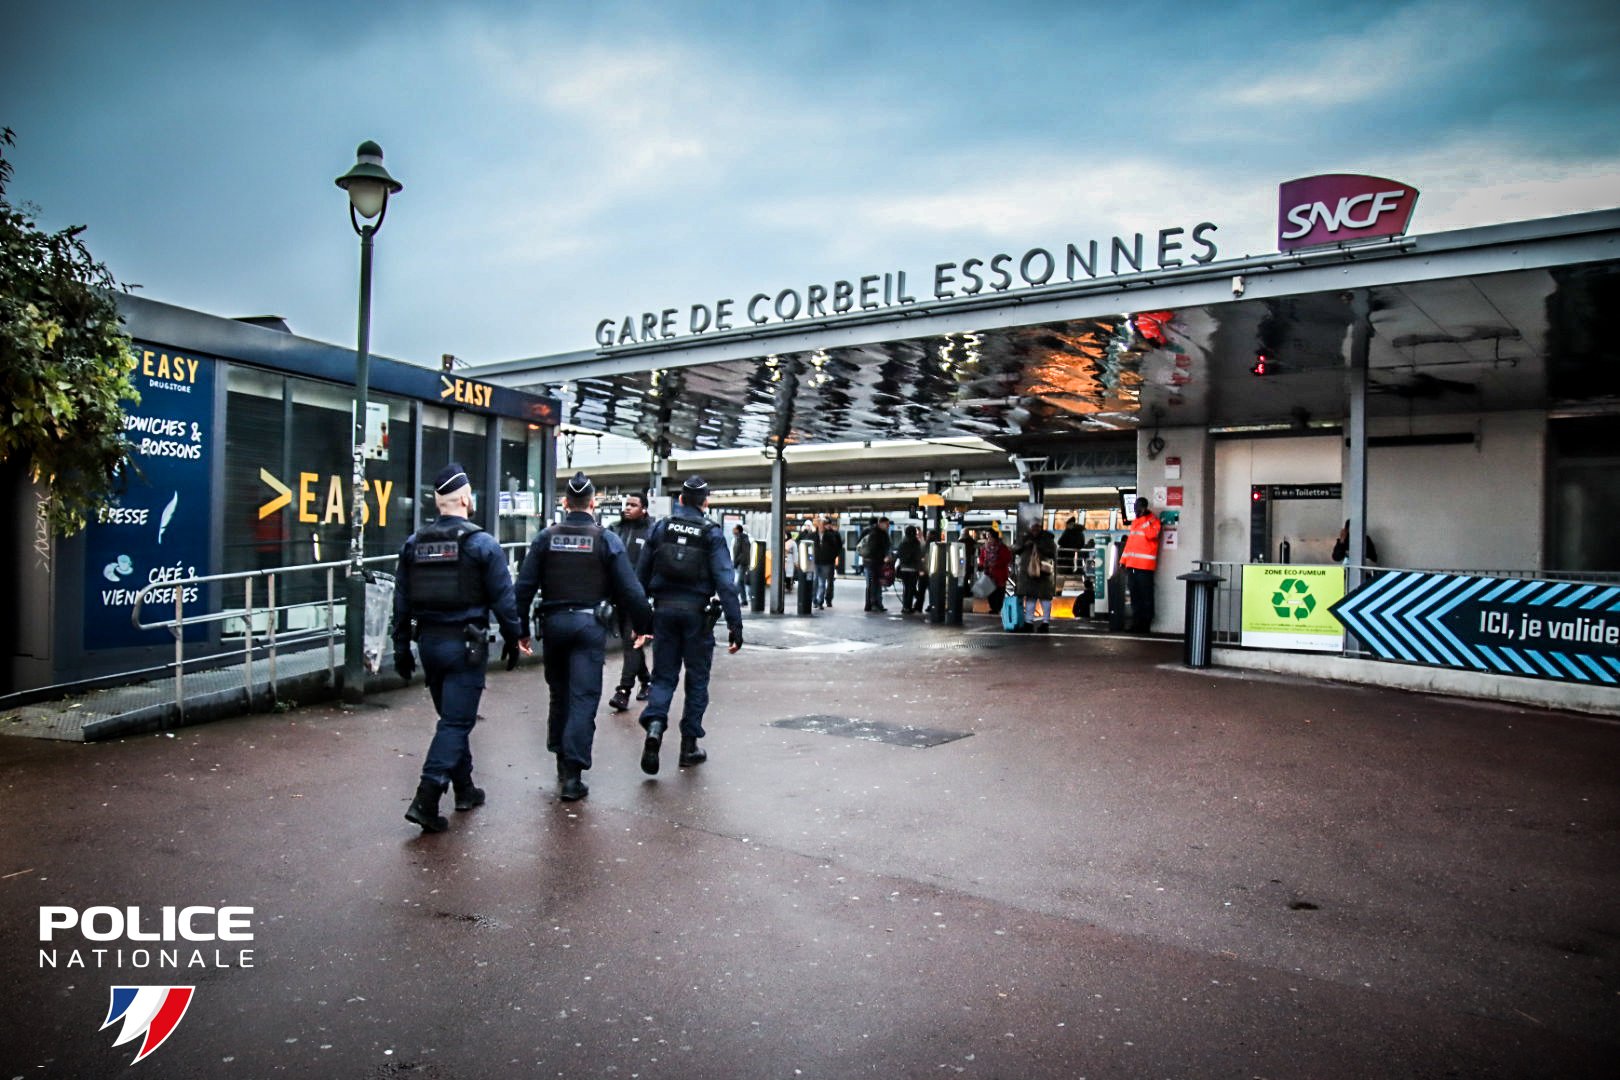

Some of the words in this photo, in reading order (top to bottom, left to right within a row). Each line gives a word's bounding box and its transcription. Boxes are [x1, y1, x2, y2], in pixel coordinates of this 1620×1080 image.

[1282, 190, 1405, 239] SNCF
[595, 308, 678, 345] GARE
[690, 299, 734, 333] DE
[747, 270, 915, 325] CORBEIL
[934, 221, 1219, 298] ESSONNES
[143, 350, 199, 384] EASY
[454, 378, 493, 408] EASY
[190, 421, 203, 442] &
[140, 437, 202, 460] BOISSONS
[1295, 488, 1330, 497] Toilettes
[667, 522, 701, 536] POLICE
[148, 561, 183, 584] CAFÉ
[1479, 610, 1515, 639] ICI,
[1518, 612, 1542, 640] je
[1548, 617, 1620, 645] valide
